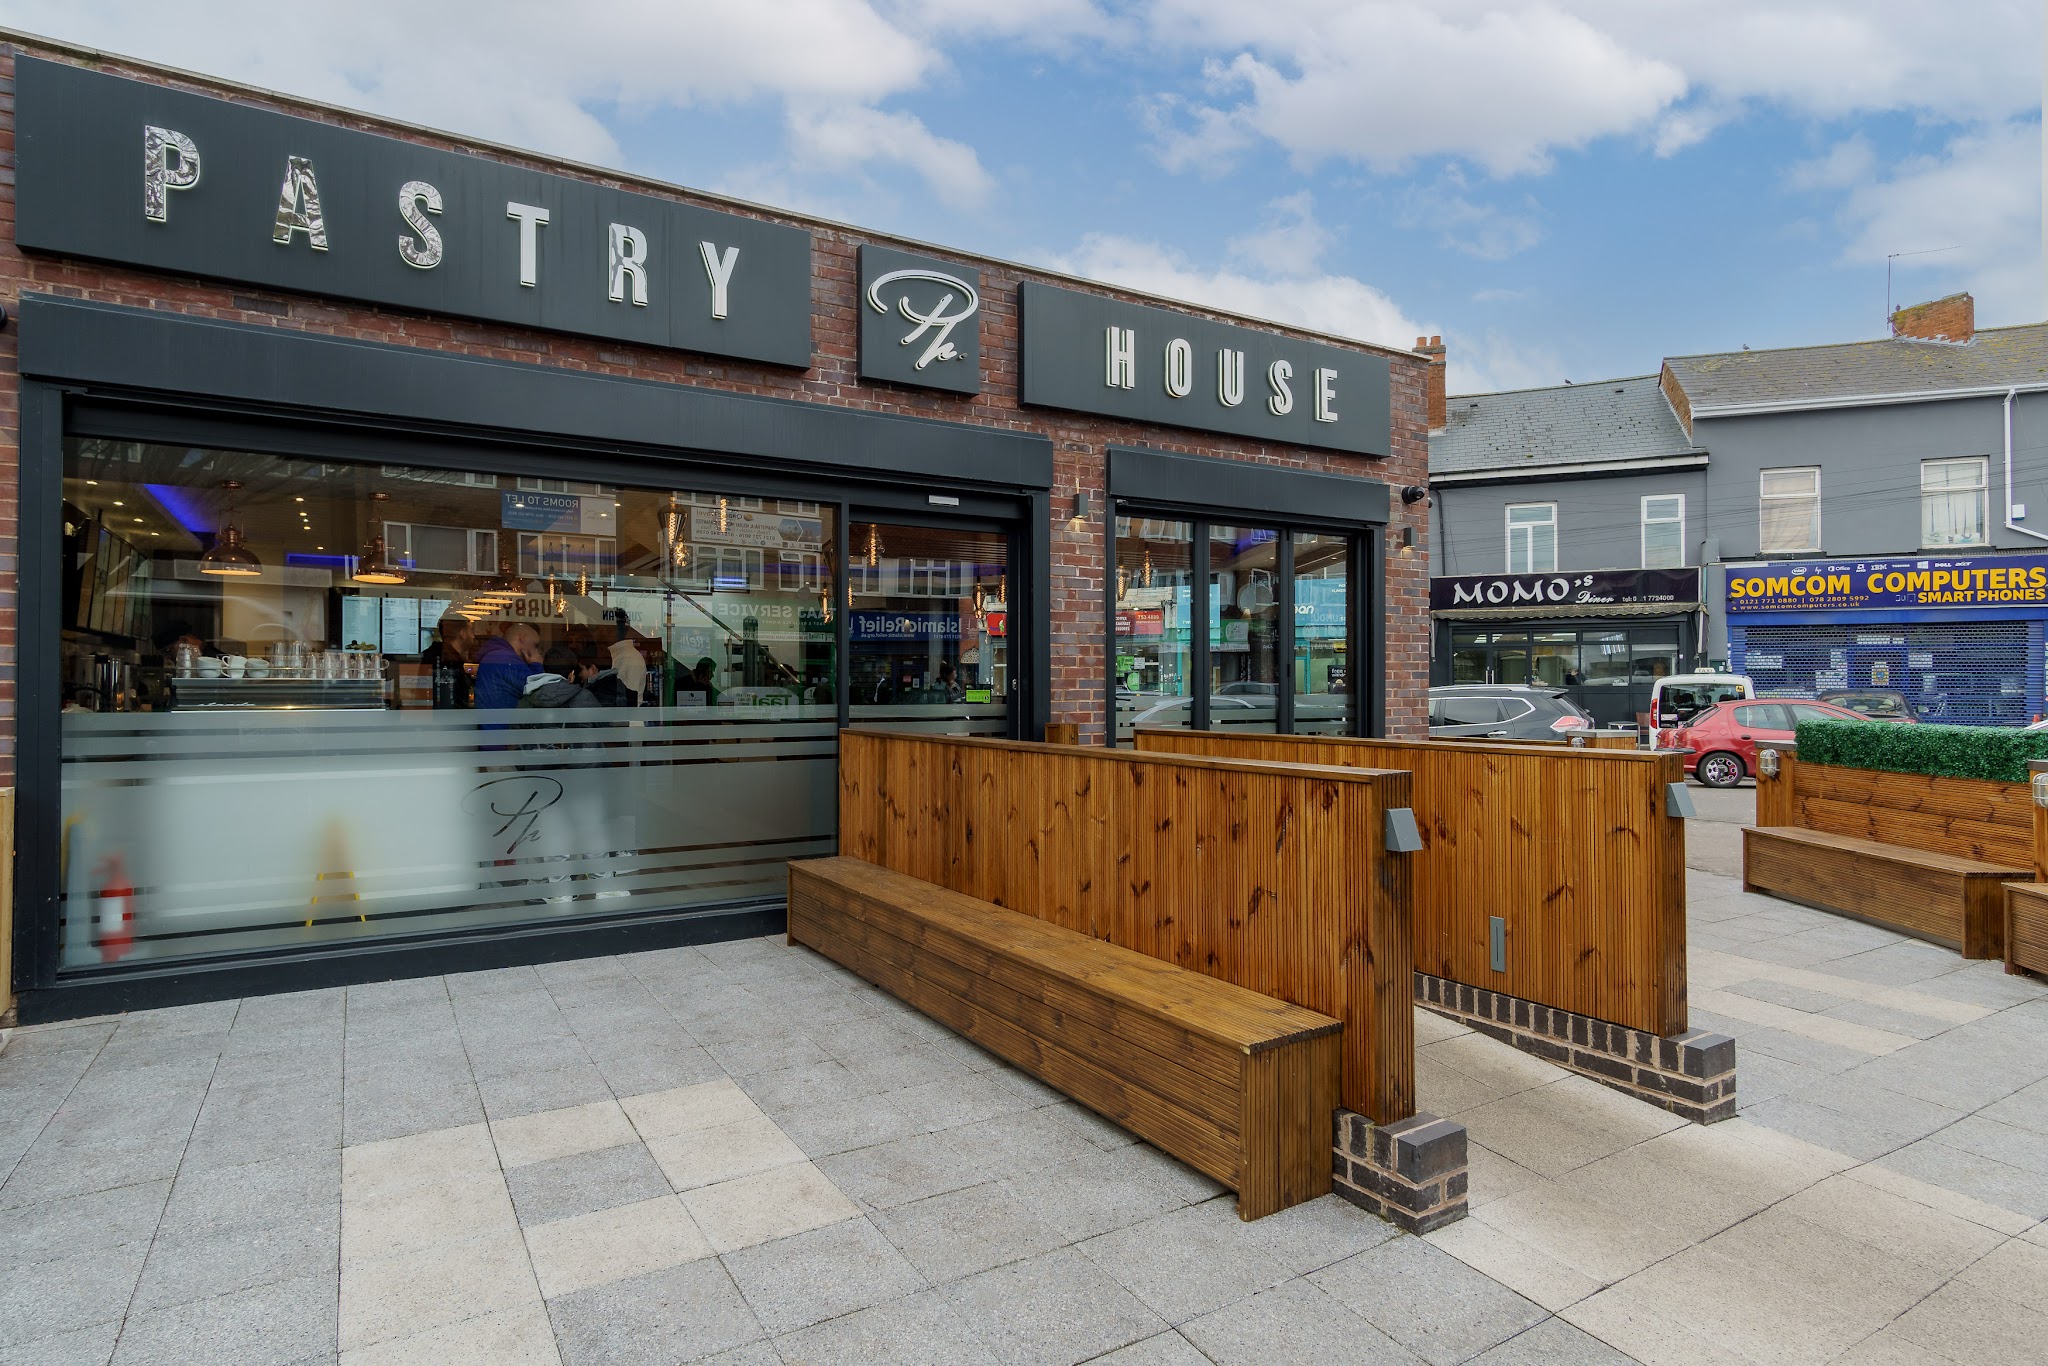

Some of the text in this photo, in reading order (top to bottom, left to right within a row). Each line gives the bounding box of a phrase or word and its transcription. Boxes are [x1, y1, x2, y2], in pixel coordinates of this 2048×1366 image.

[144, 124, 740, 321] PASTRY
[1105, 325, 1340, 424] HOUSE
[1730, 566, 2047, 598] SOMCOM COMPUTERS
[1575, 590, 1615, 604] Diner
[1740, 601, 1860, 610] www.somcomcomputers.co.uk
[1917, 588, 2047, 604] SMART PHONES
